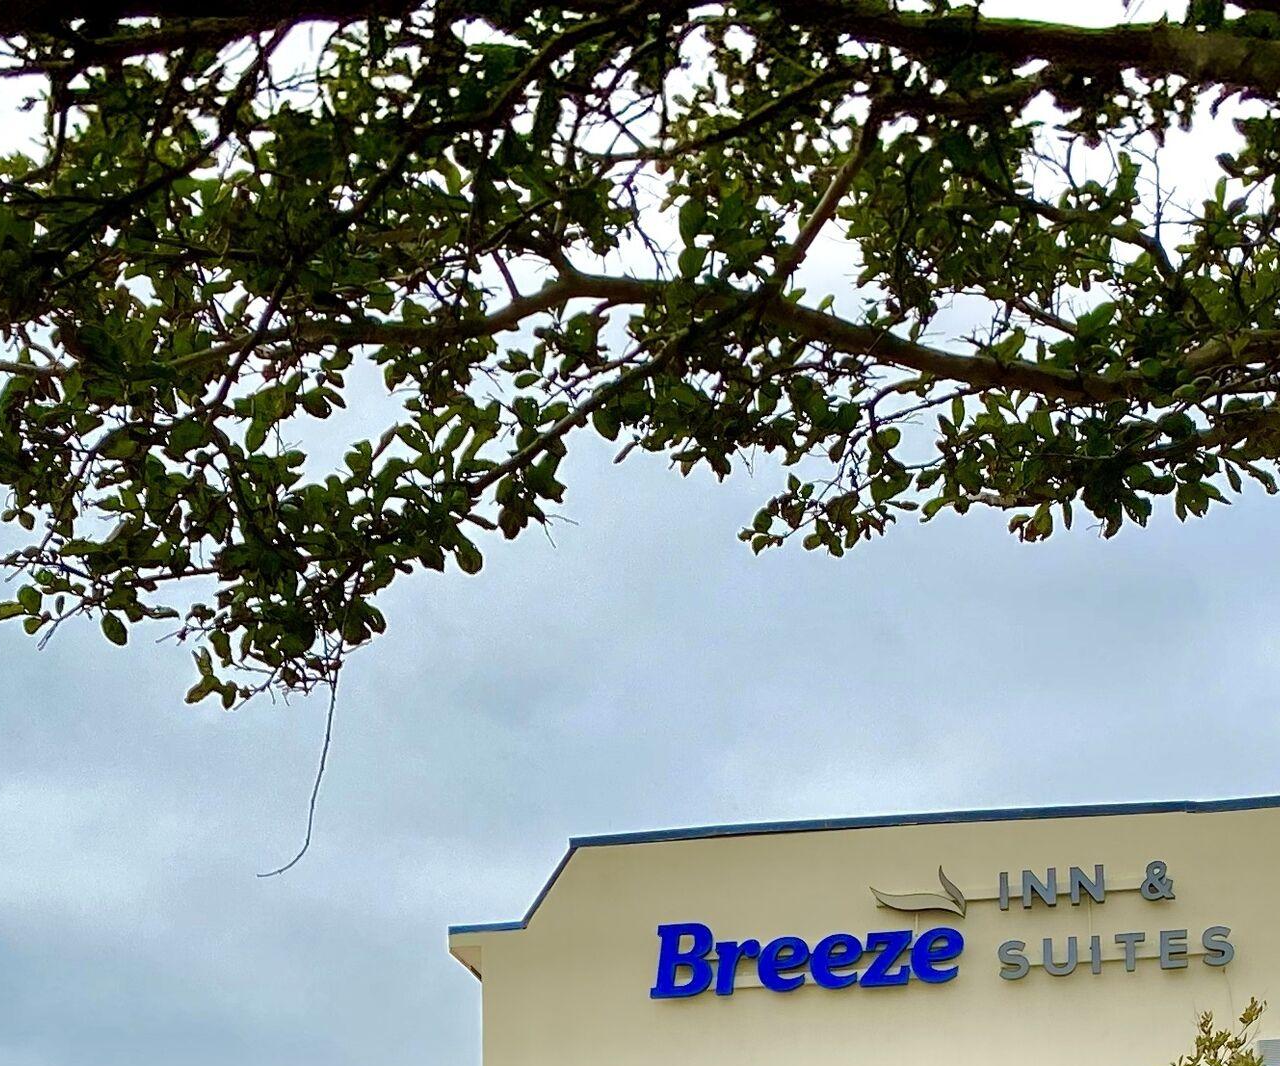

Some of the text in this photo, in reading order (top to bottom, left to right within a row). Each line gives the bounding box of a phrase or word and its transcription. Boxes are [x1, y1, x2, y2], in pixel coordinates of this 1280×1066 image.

[999, 860, 1176, 911] INN &
[650, 923, 964, 999] Breeze
[997, 925, 1235, 980] SUITES
